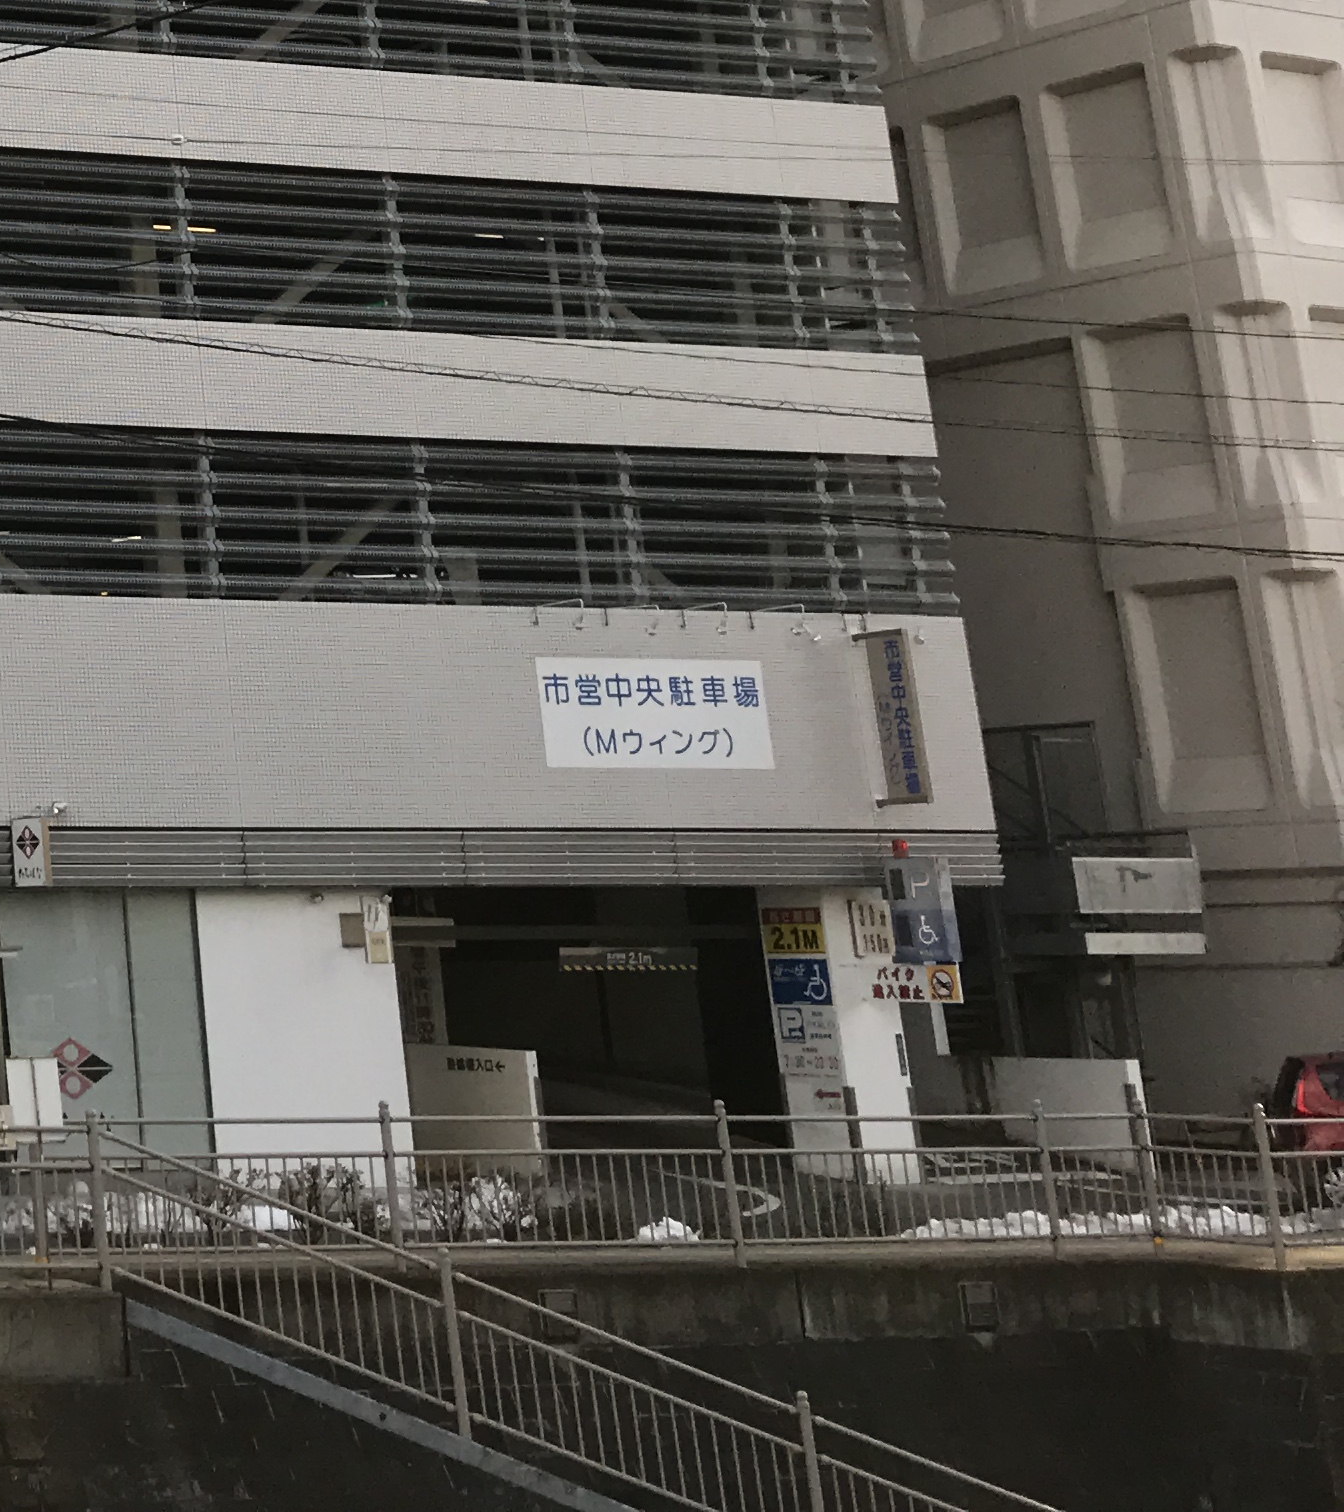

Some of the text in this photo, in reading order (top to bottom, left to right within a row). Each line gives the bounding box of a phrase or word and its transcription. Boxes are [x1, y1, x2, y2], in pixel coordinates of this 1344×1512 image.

[542, 672, 760, 708] 市営中央駐車場
[883, 639, 921, 794] 市営中央駐車場
[771, 926, 820, 950] 2.1M
